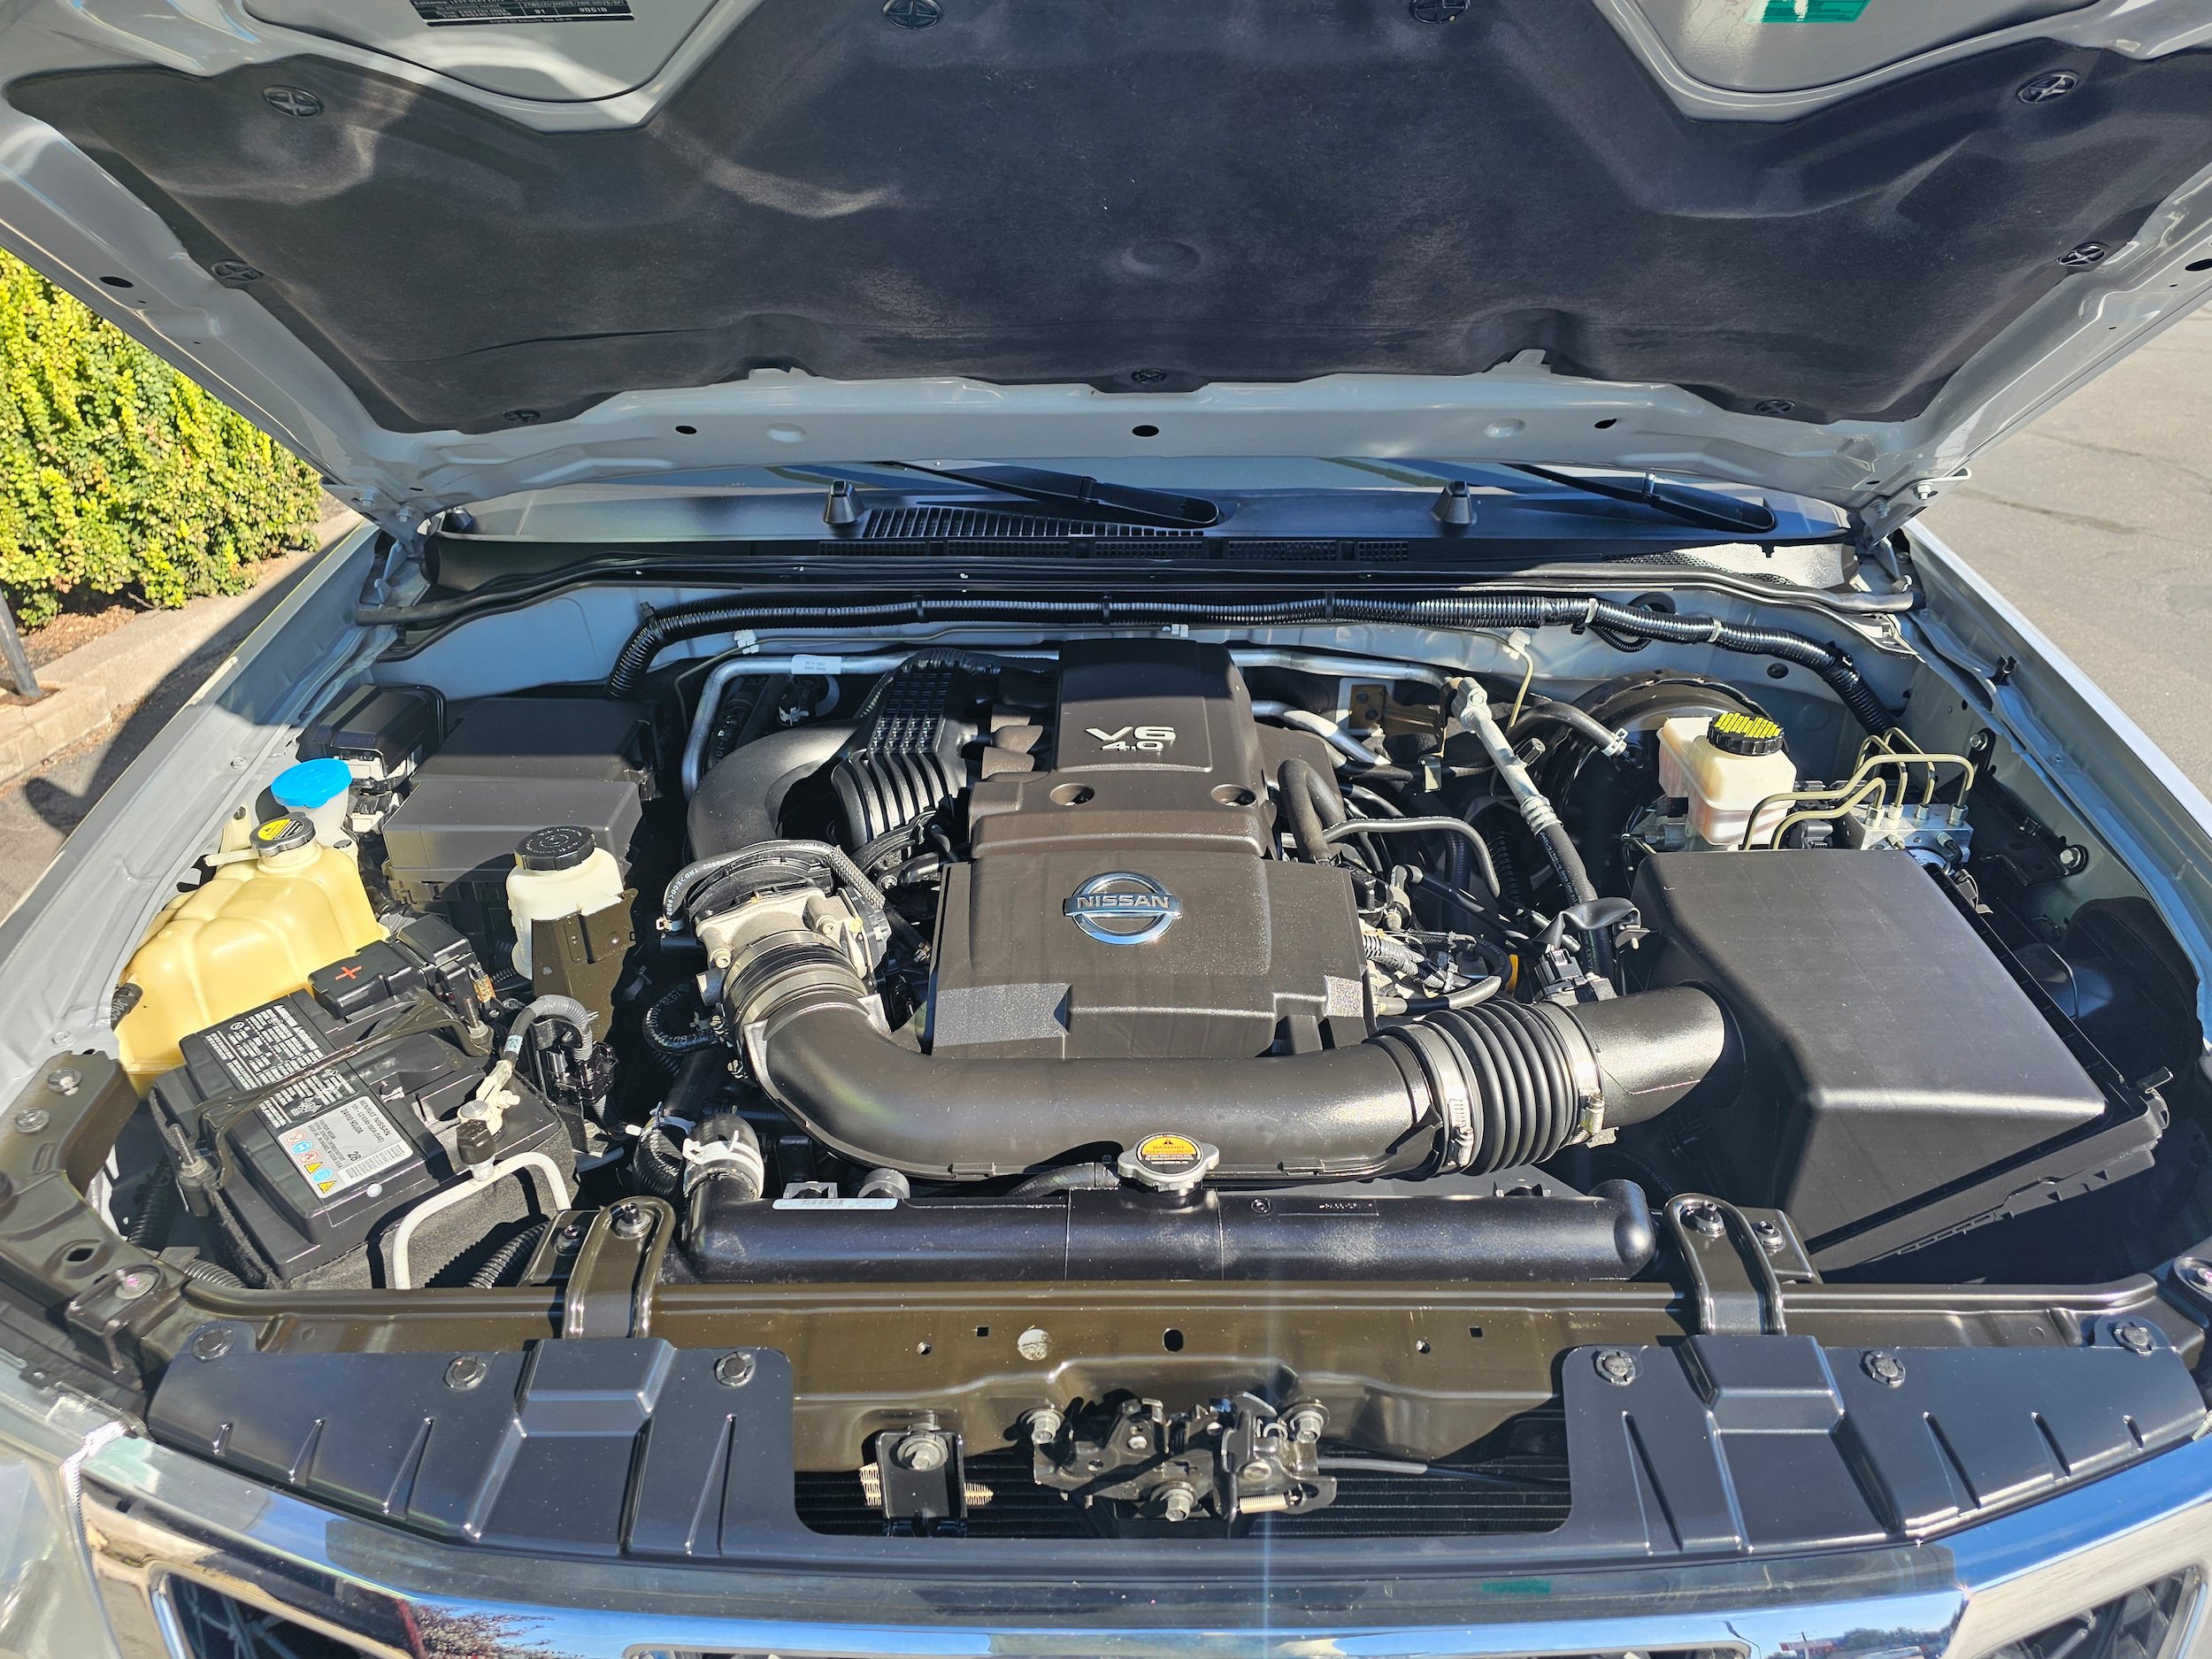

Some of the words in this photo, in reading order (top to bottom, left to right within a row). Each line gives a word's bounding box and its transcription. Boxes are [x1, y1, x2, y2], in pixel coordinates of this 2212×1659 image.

[1085, 726, 1177, 741] V6
[1077, 894, 1170, 910] NISSAN
[360, 1100, 376, 1117] RENAULT
[373, 1117, 392, 1136] NISSAN
[347, 1150, 362, 1161] 28
